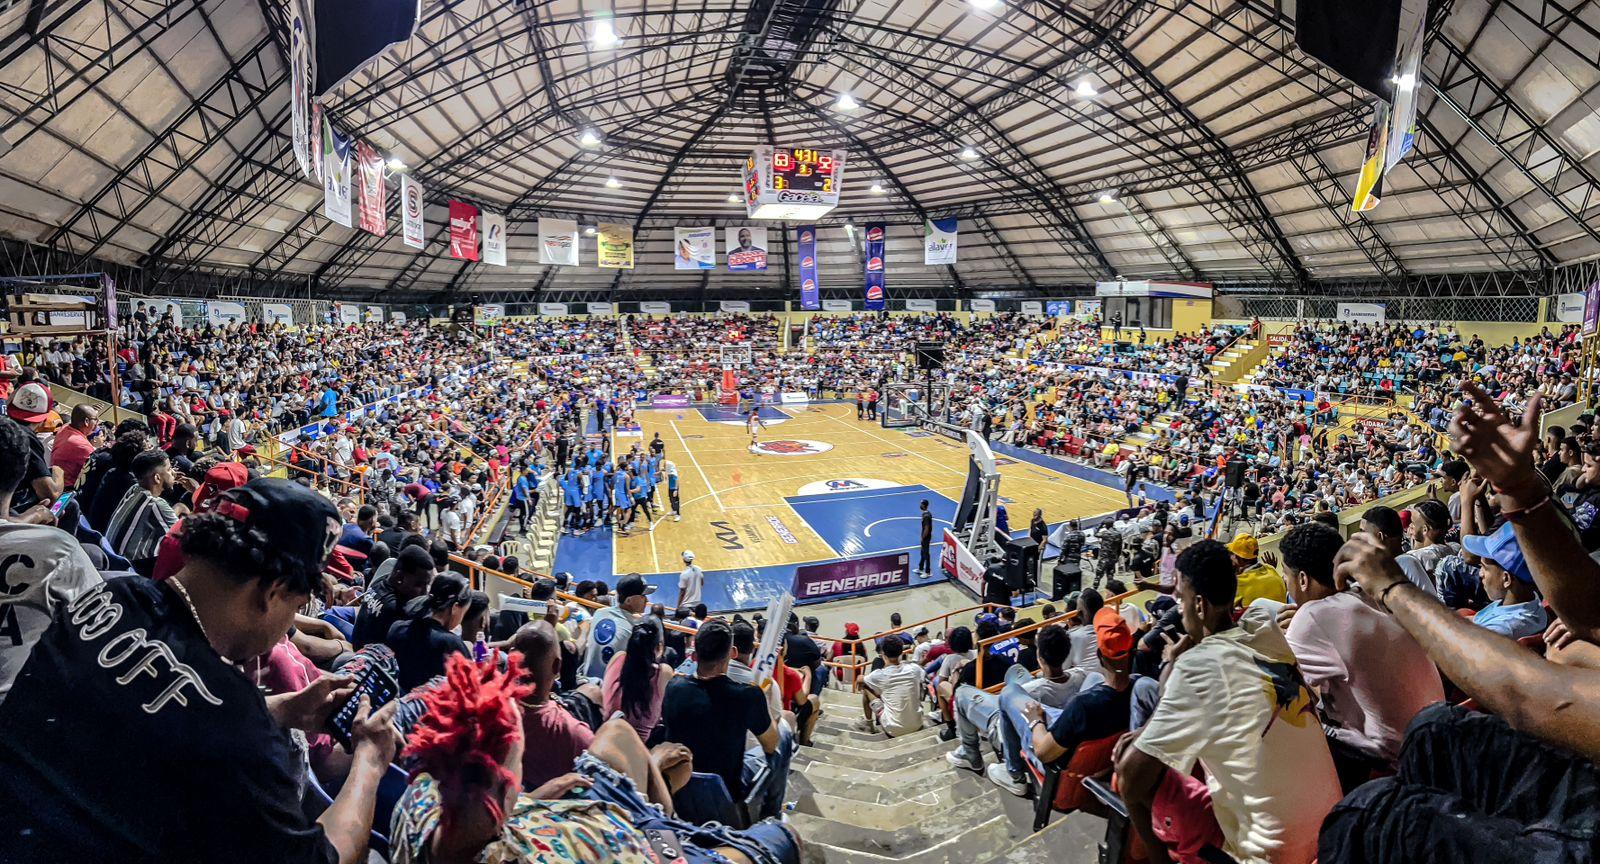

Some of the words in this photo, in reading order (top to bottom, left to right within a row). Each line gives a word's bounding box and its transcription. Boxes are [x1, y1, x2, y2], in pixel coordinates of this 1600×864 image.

[778, 190, 823, 203] Gacea
[805, 569, 903, 596] GENERADE
[97, 628, 224, 714] OFF
